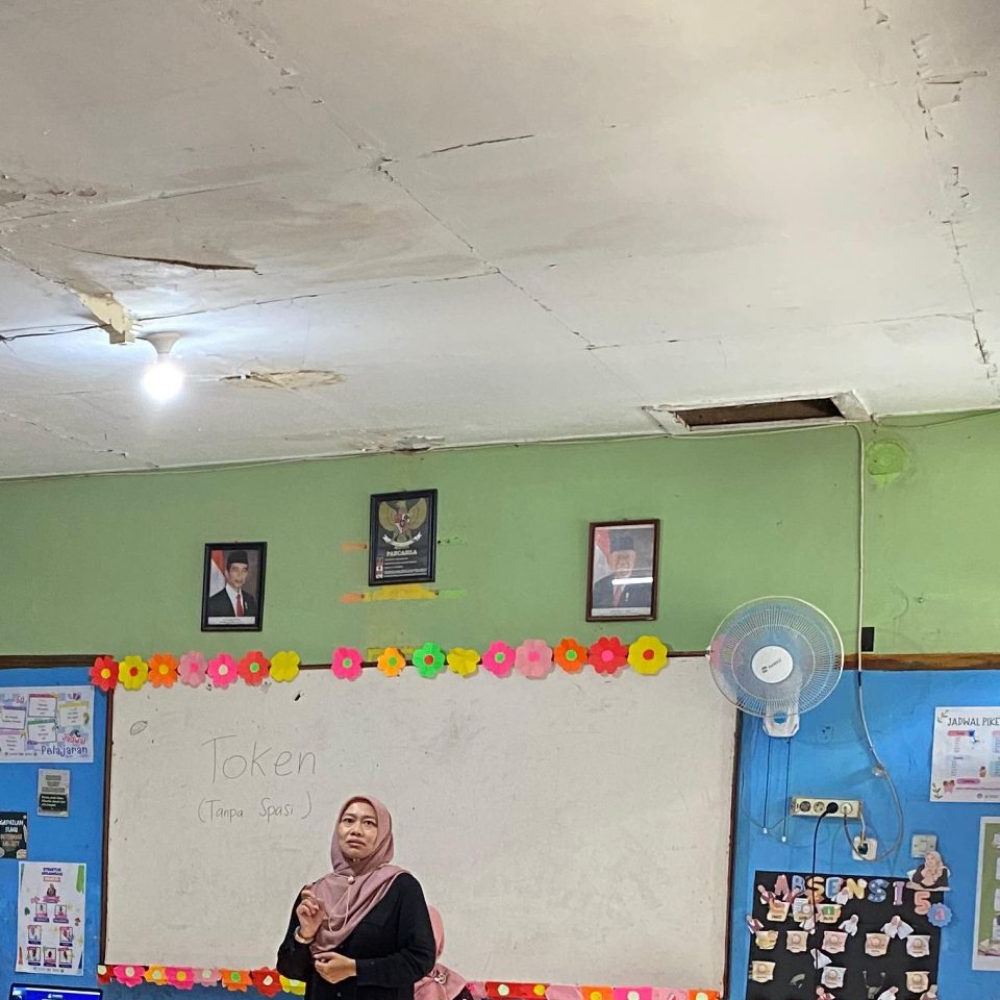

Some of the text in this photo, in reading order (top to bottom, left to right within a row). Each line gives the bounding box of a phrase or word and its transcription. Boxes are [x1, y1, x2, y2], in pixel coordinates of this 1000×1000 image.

[947, 717, 1000, 726] JADWAL PIKE
[41, 745, 88, 757] Pelajaran
[201, 734, 316, 783] Token
[774, 874, 906, 906] ABSENSI
[914, 891, 932, 915] 5
